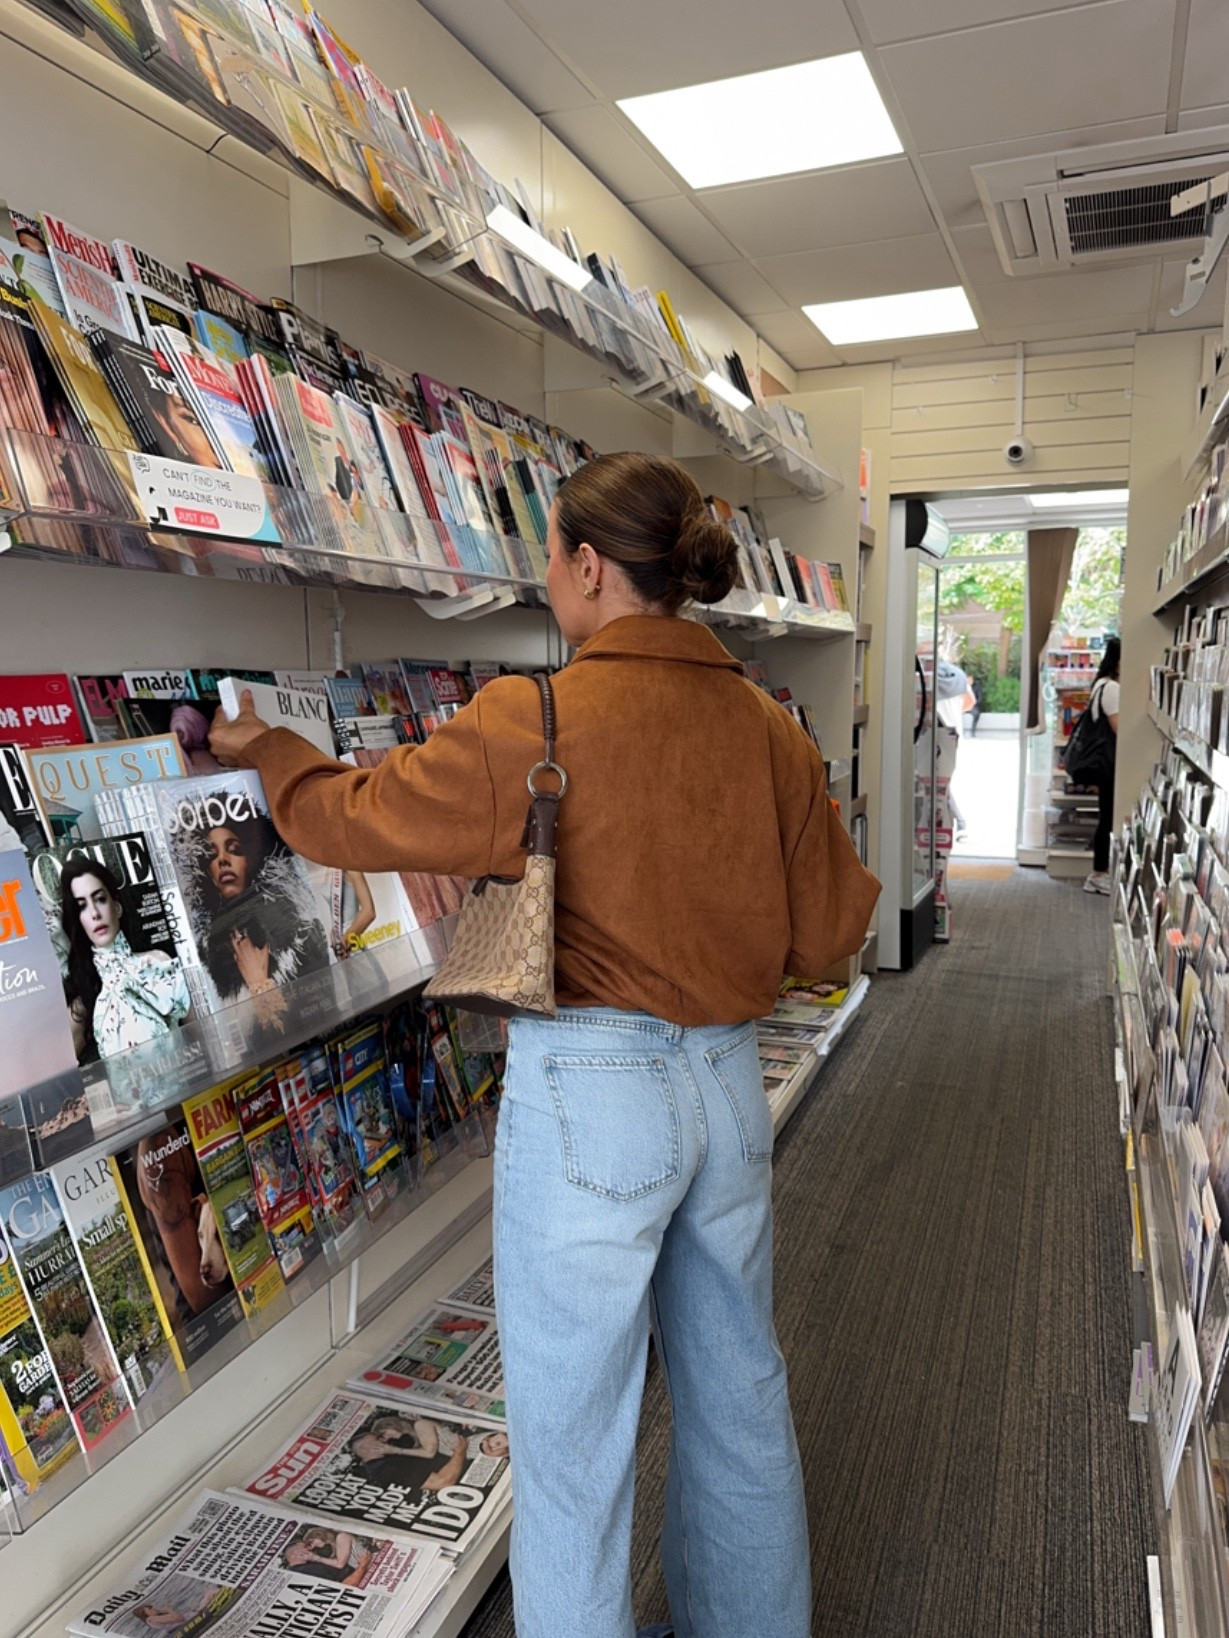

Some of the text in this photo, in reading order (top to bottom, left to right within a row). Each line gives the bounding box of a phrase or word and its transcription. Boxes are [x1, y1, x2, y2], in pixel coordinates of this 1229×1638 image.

[163, 468, 232, 492] CAN'T FIND THE
[168, 488, 261, 514] MAGAZINE YOU WANT?
[178, 511, 217, 527] JUST ASK
[131, 671, 184, 692] marie
[22, 704, 73, 727] PULP
[276, 691, 328, 723] BLANC
[40, 747, 170, 801] QUEST
[163, 782, 260, 833] Sorbet
[64, 1157, 113, 1201] GAR
[9, 1192, 61, 1241] GA
[82, 1215, 115, 1251] Small
[11, 1360, 27, 1384] 2
[255, 1441, 322, 1497] Sun
[318, 1473, 367, 1512] WHAT
[345, 1483, 385, 1511] YOU
[363, 1483, 411, 1523] MADE
[419, 1485, 485, 1534] DO
[178, 1549, 203, 1572] What
[200, 1532, 218, 1549] this
[216, 1506, 240, 1532] photo
[192, 1552, 213, 1571] says
[209, 1526, 233, 1552] about
[219, 1548, 253, 1581] driving
[245, 1516, 276, 1547] Britain
[227, 1517, 286, 1584] into the ground
[210, 1540, 245, 1579] socialist
[84, 1535, 192, 1627] Daily Mail
